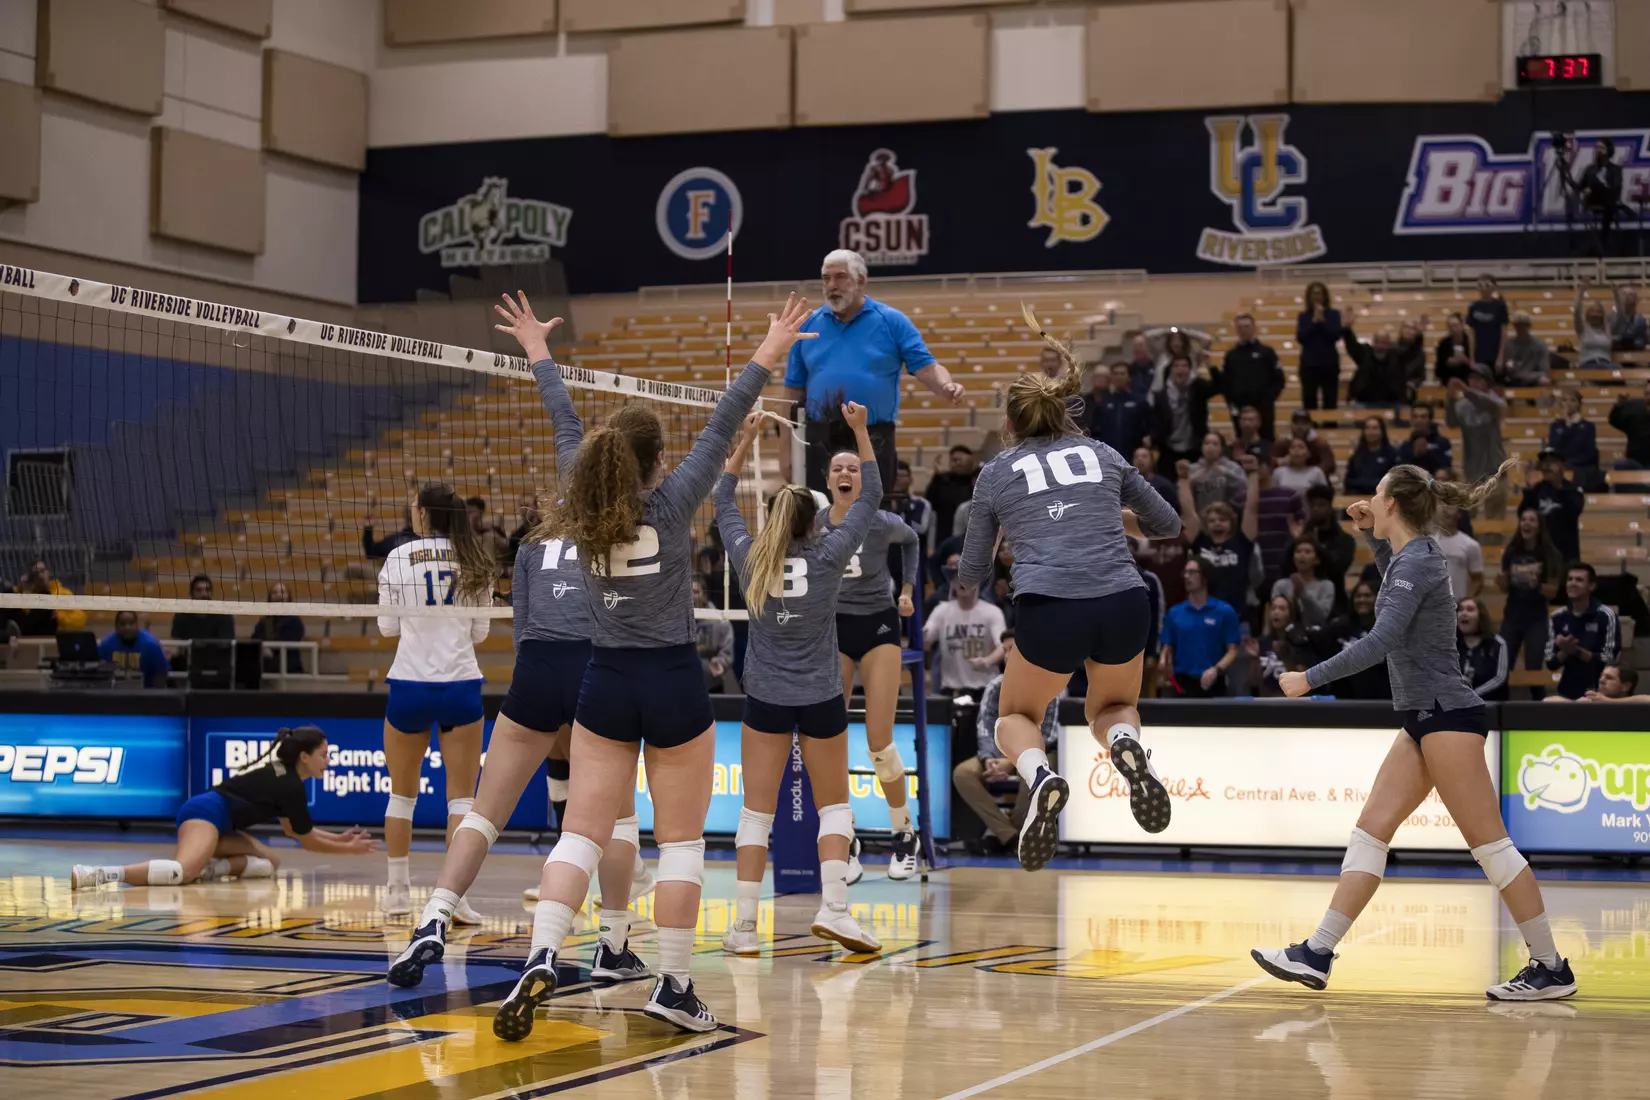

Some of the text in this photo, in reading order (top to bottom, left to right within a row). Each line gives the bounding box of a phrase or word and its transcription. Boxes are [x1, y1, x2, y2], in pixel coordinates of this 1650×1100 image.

[1544, 57, 1589, 79] 7:37
[423, 203, 567, 249] CAL POLY
[685, 189, 716, 240] F
[843, 218, 926, 252] CSUN
[1201, 229, 1322, 262] RIVERSIDE
[110, 285, 260, 328] UC RIVERSIDE VOLLEYBALL
[320, 324, 443, 359] UC RIVERSIDE VOLLEYBALL
[493, 353, 595, 384] UC RIVER OLLEYBALL
[636, 379, 721, 404] UC RIVERSIDE VOLLEYBAL
[1011, 445, 1103, 495] 10
[424, 571, 457, 606] 17
[0, 745, 124, 784] PEPSI
[323, 770, 371, 797] light
[1224, 786, 1283, 801] Central
[1288, 788, 1322, 802] Ave.
[1327, 788, 1338, 802] &
[1602, 813, 1642, 828] Mark
[1633, 832, 1650, 843] 90
